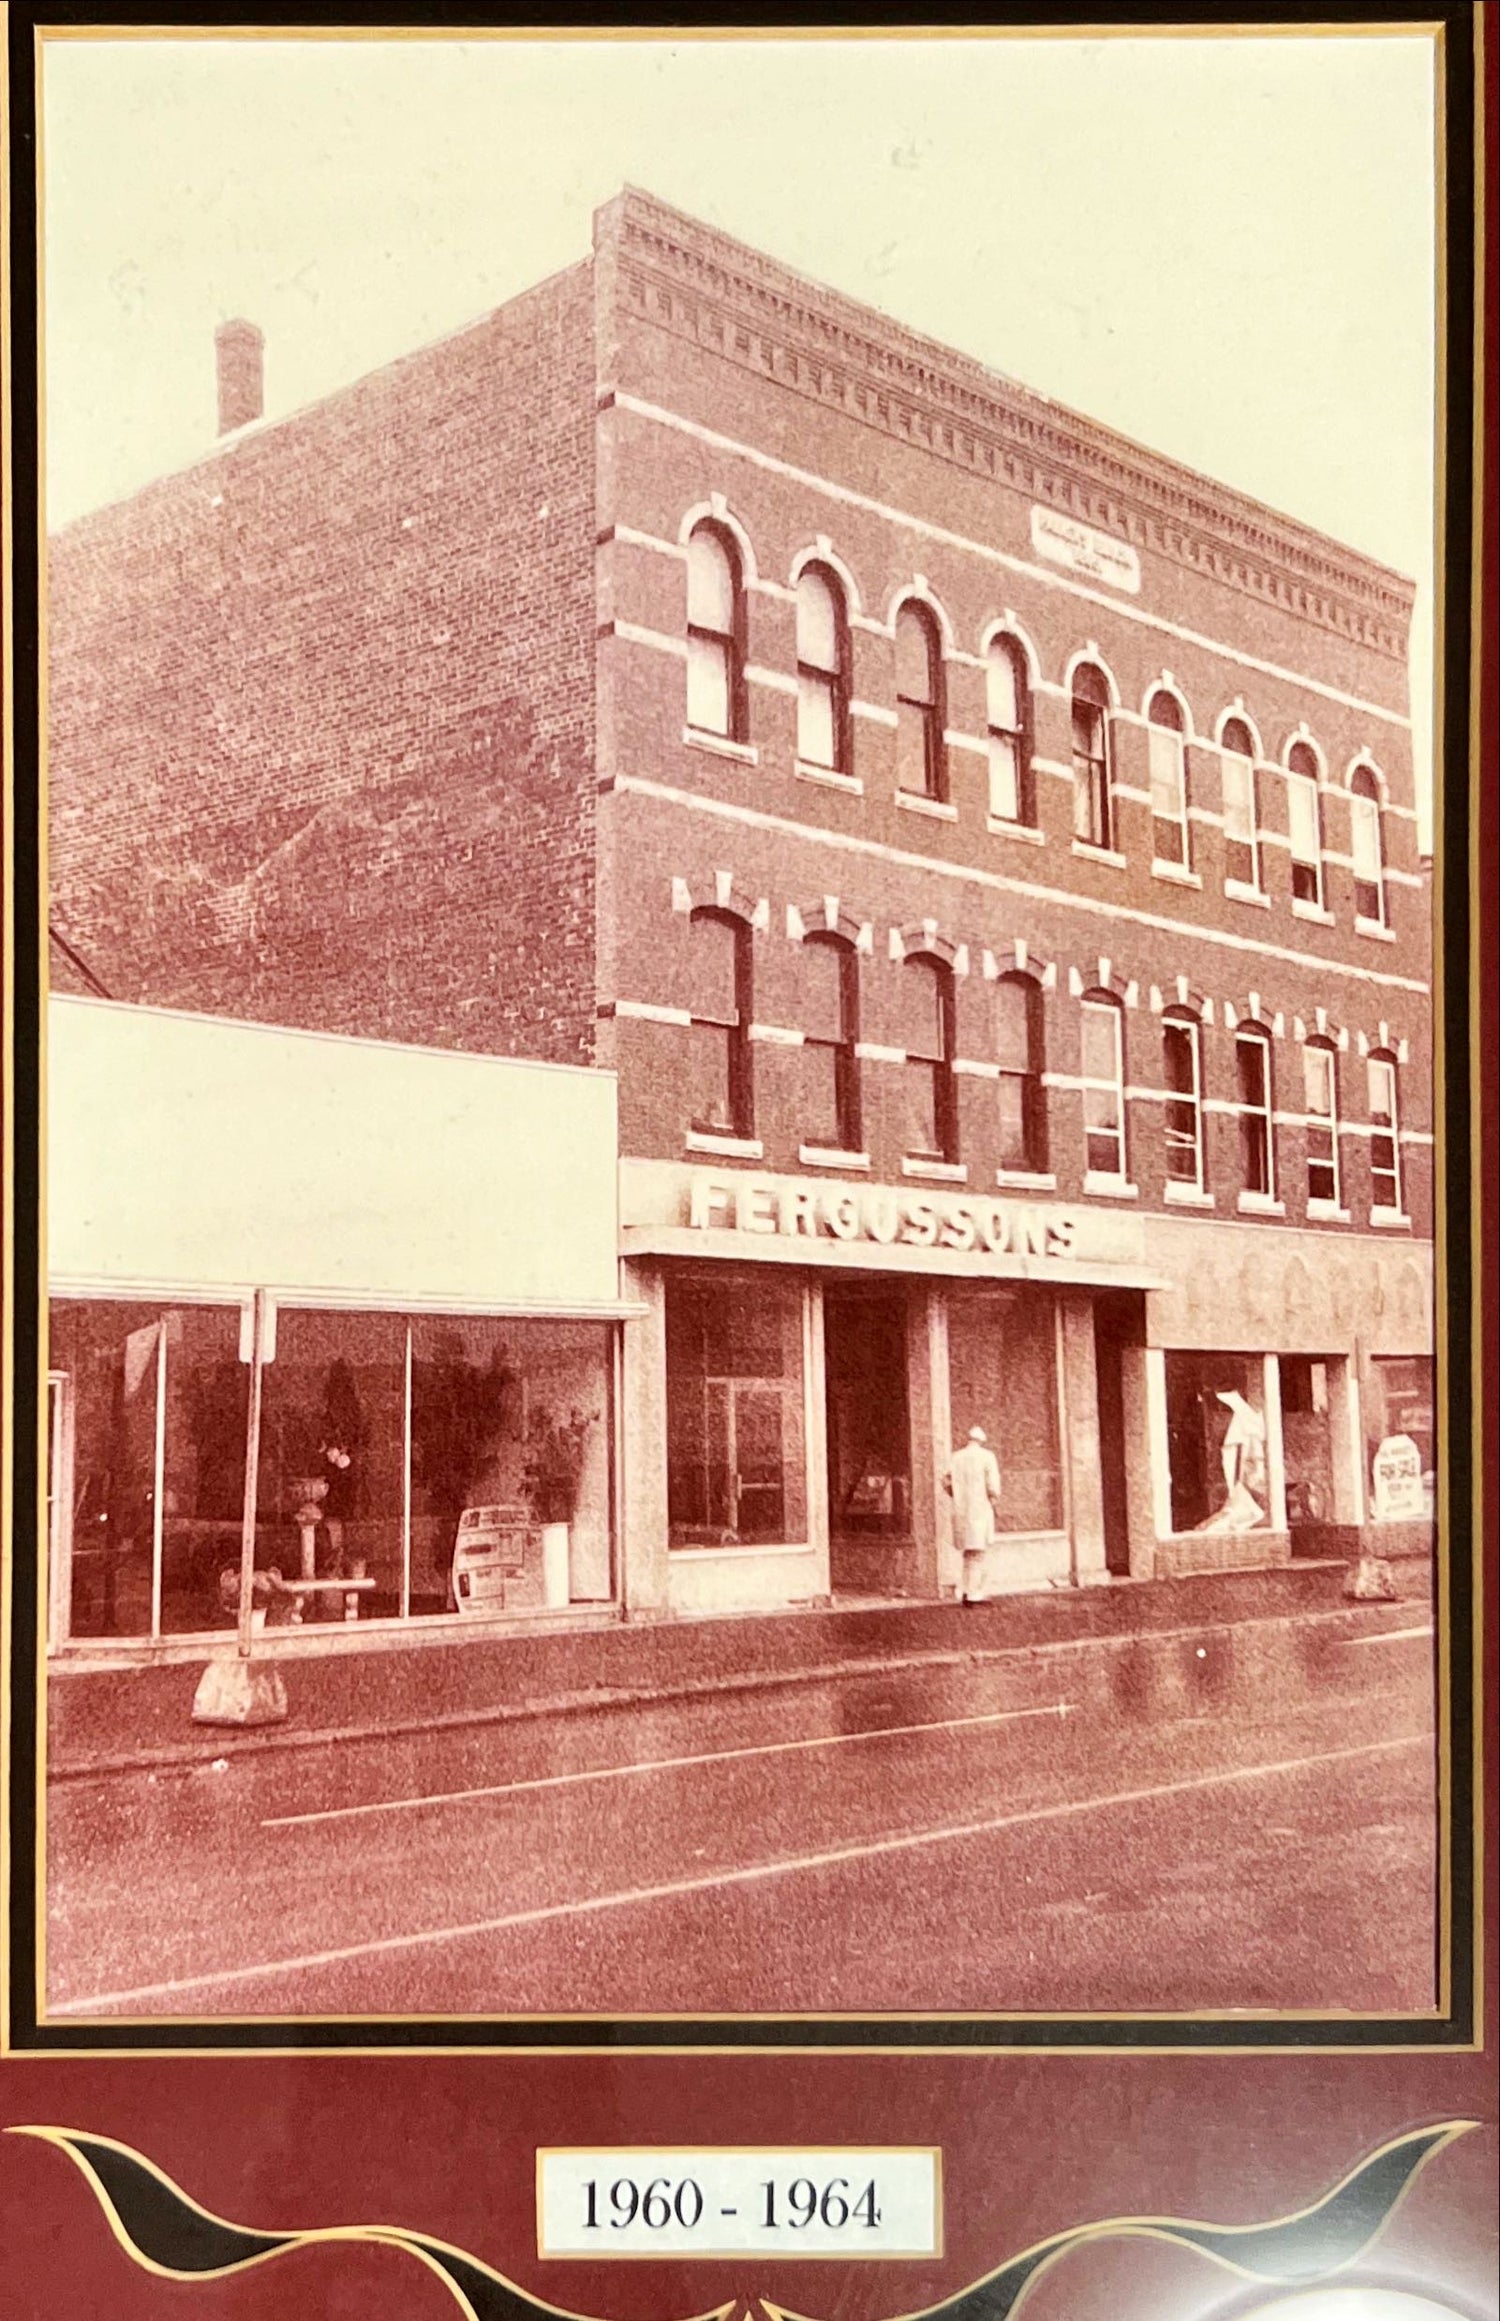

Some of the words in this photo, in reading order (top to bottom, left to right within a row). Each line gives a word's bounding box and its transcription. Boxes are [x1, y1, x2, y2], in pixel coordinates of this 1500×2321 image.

[689, 1180, 1079, 1259] FERGUSSONS
[581, 2178, 704, 2229] 1960
[759, 2178, 882, 2229] 1964
